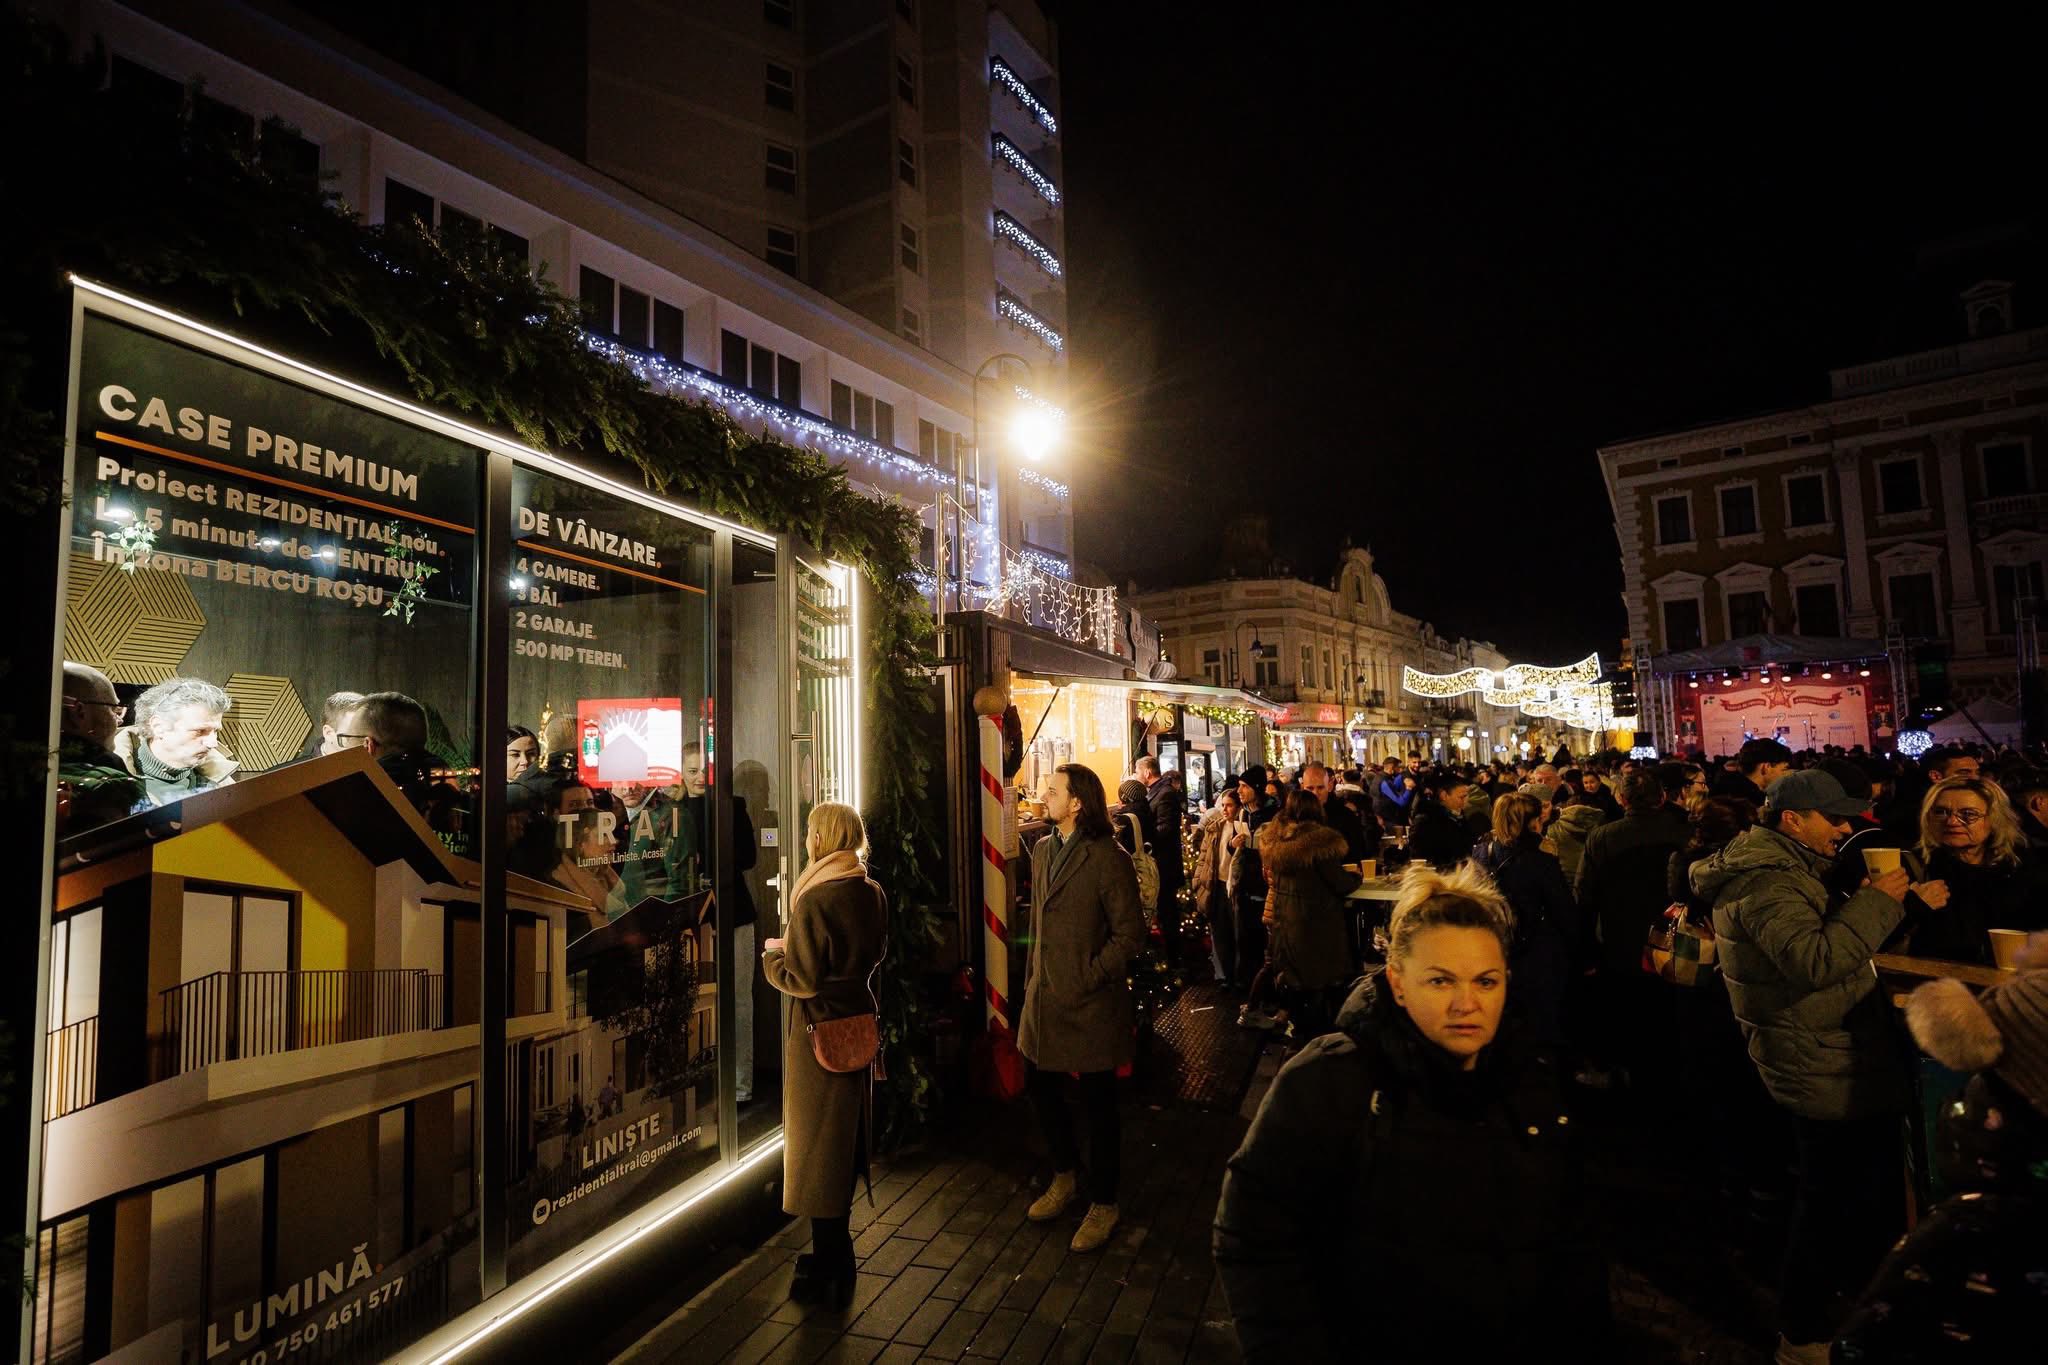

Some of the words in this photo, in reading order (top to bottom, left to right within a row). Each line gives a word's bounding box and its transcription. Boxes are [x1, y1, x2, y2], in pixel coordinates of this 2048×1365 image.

[99, 384, 232, 451] CASE
[247, 426, 417, 501] PREMIUM
[97, 456, 217, 506] Proiect
[400, 533, 446, 558] nou.
[281, 537, 313, 560] de
[519, 507, 550, 537] DE
[556, 518, 663, 568] VÂNZARE.
[216, 558, 310, 595] BERCU
[516, 557, 529, 575] 4
[532, 561, 601, 591] CAMERE.
[515, 611, 527, 629] 2
[530, 614, 598, 640] GARAJE.
[515, 638, 548, 659] 500
[551, 643, 574, 661] MP
[576, 648, 629, 671] TEREN.
[552, 1125, 702, 1213] rezidentialtrai@gmail.com
[274, 1322, 319, 1361] 750
[325, 1298, 361, 1331] 461
[368, 1276, 404, 1310] 577
